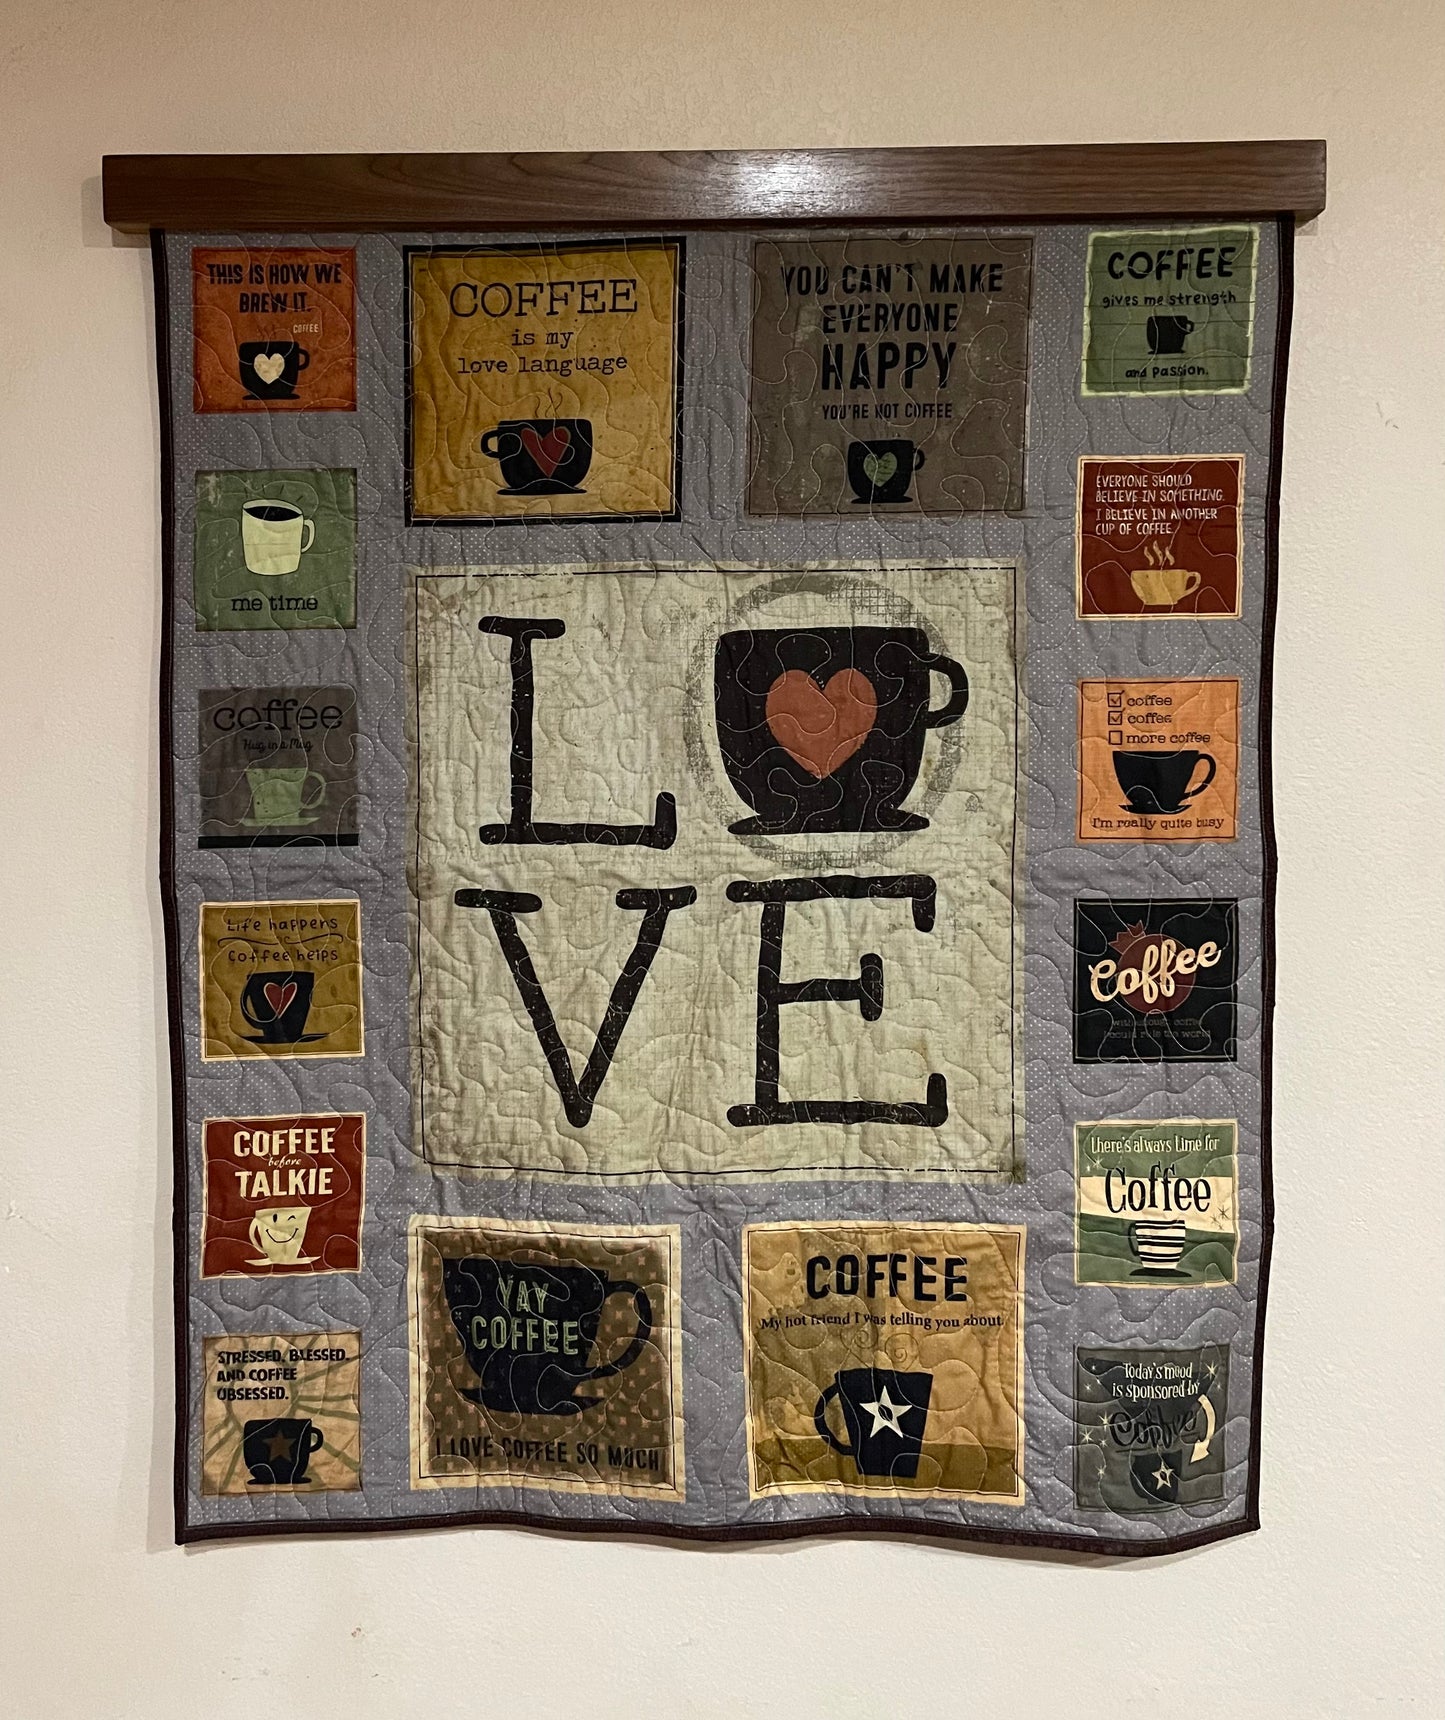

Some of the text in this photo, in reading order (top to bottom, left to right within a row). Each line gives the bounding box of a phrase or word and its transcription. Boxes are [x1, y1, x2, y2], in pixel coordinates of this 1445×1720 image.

[1107, 246, 1236, 280] COFFEE
[206, 263, 342, 284] THIS IS HOW WE
[781, 263, 1003, 296] YOU CAN'T MAKE
[239, 292, 288, 313] BREW
[450, 278, 638, 317] COFFEE
[1102, 291, 1236, 309] gives me strength
[822, 303, 958, 334] EVERYONE
[293, 323, 319, 333] COFFEE
[511, 329, 574, 349] is my
[457, 355, 628, 378] love language
[821, 342, 957, 391] HAPPY
[1125, 365, 1209, 379] and passion.
[822, 403, 952, 420] YOU'RE NOT COFFEE
[1096, 474, 1192, 488] EVERYONE SHOULD
[1095, 490, 1138, 503] BELIEVE
[1142, 490, 1156, 502] IN
[1096, 508, 1217, 521] I BELIEVE IN ANOTHER
[1095, 523, 1115, 535] CUP
[1119, 522, 1133, 535] OF
[231, 595, 318, 611] me time
[1126, 695, 1173, 706] coffee
[213, 699, 343, 731] coffee
[1127, 713, 1172, 724] coffee
[242, 738, 313, 753] Hug in a Mug
[1126, 731, 1211, 744] more coffee
[1092, 817, 1225, 830] I'm really quite busy
[227, 917, 338, 932] Life happens
[228, 949, 338, 962] Coffee helps
[1088, 939, 1222, 1004] Coffee
[233, 1127, 336, 1157] COFFEE
[1133, 1136, 1172, 1153] always
[1175, 1135, 1202, 1153] time
[1205, 1133, 1220, 1151] for
[268, 1156, 302, 1169] before
[234, 1167, 334, 1198] TALKIE
[1105, 1161, 1212, 1213] Coffee
[806, 1253, 968, 1302] COFFEE
[499, 1277, 549, 1313] YAY
[761, 1317, 781, 1331] My
[785, 1315, 807, 1328] hot
[811, 1312, 850, 1325] friend
[854, 1312, 860, 1323] I
[864, 1314, 886, 1325] was
[890, 1312, 932, 1330] telling
[935, 1318, 960, 1331] you
[471, 1315, 579, 1355] COFFEE
[217, 1348, 350, 1364] STRESSED. BLESSED.
[217, 1367, 298, 1382] AND COFFEE
[1122, 1362, 1193, 1380] Today's mood
[217, 1386, 289, 1401] OBSESSED.
[1112, 1379, 1200, 1403] is sponsored by
[436, 1437, 659, 1471] I LOVE COFFEE SO MUCH
